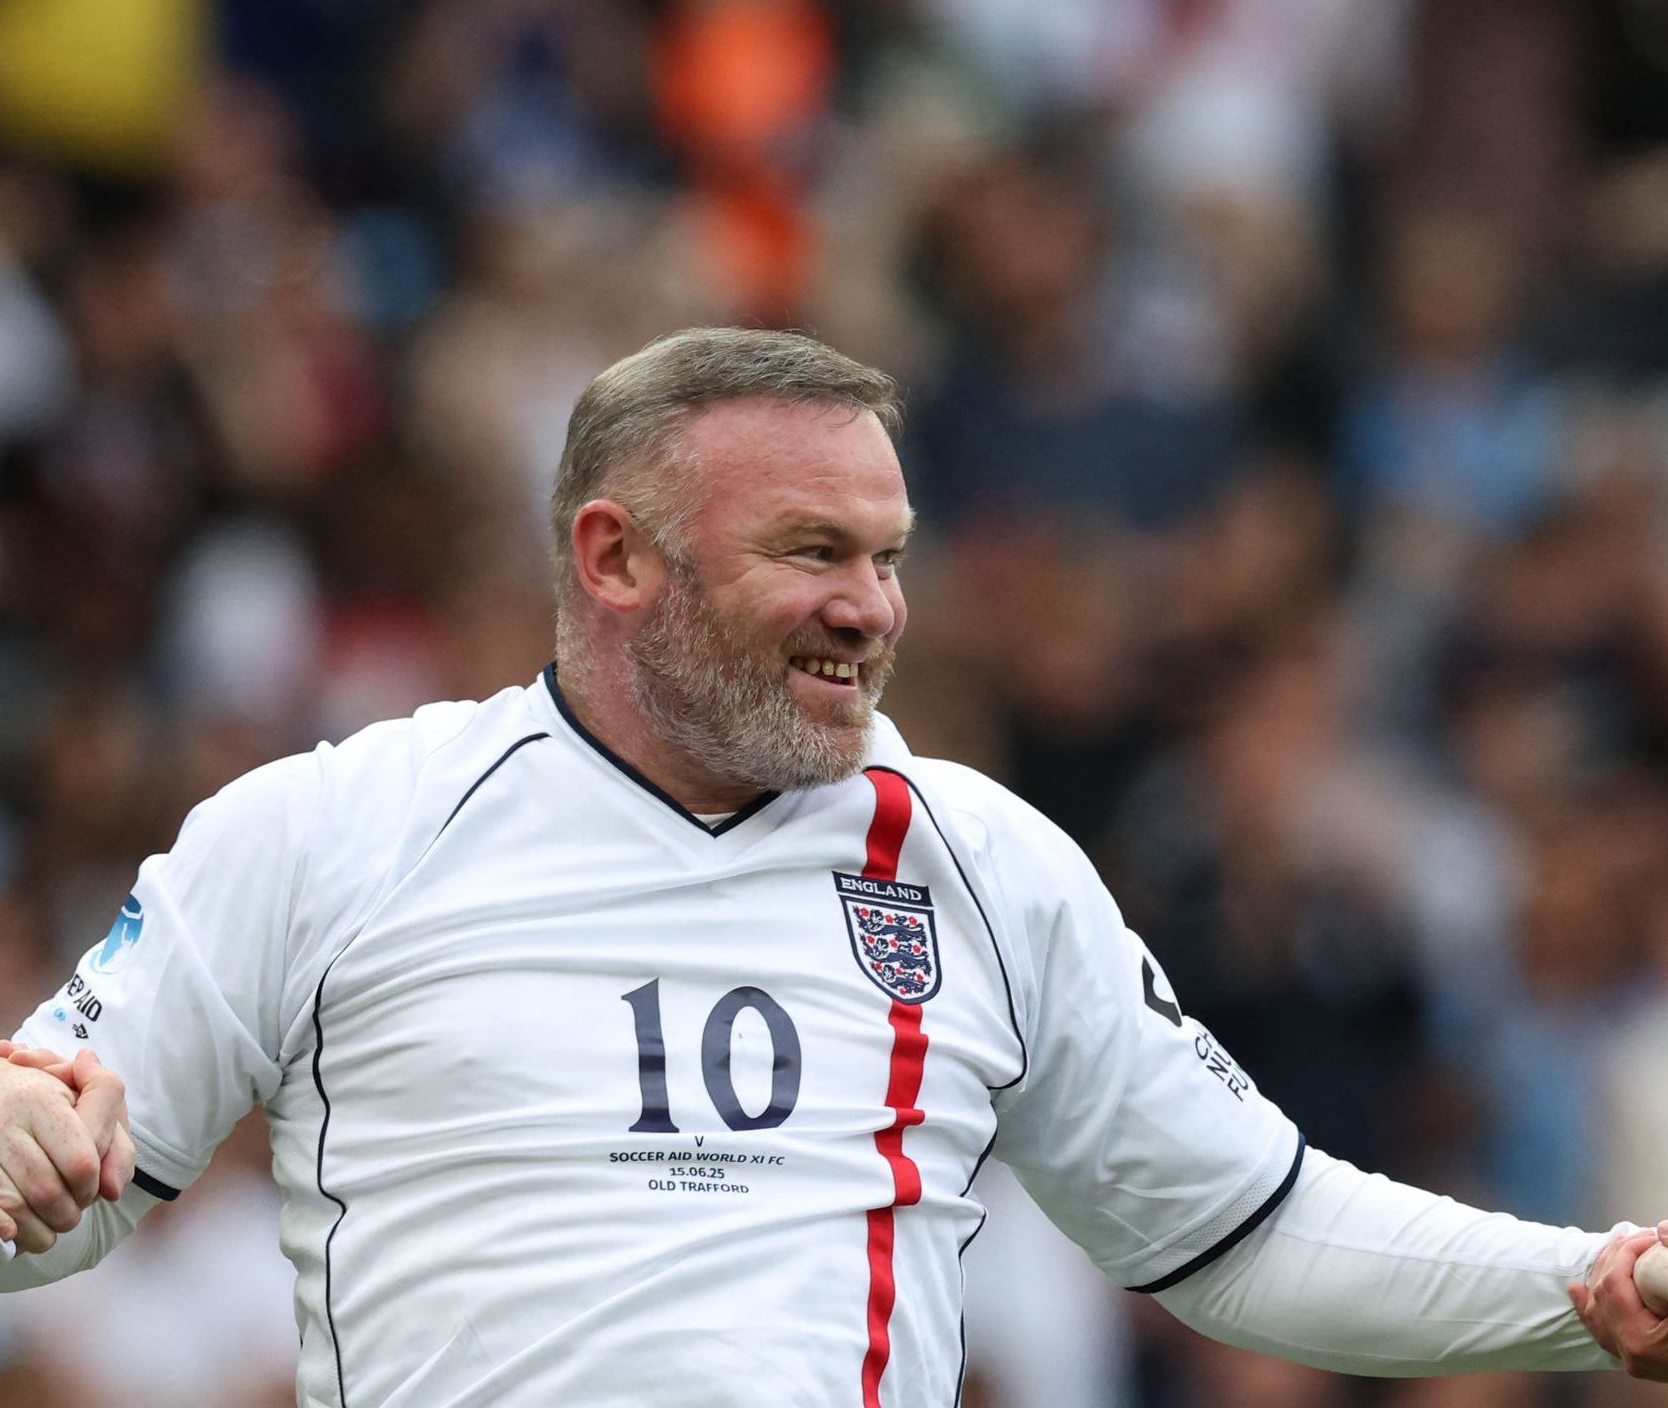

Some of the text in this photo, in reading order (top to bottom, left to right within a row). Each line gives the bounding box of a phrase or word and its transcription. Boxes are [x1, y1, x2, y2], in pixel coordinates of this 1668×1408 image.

[839, 877, 923, 901] ENGLAND
[621, 977, 802, 1133] 10
[609, 1151, 785, 1166] SOCCER AID WORLD XI FC
[669, 1166, 725, 1180] 15.06.25
[648, 1179, 750, 1194] OLD TRAFFORD
